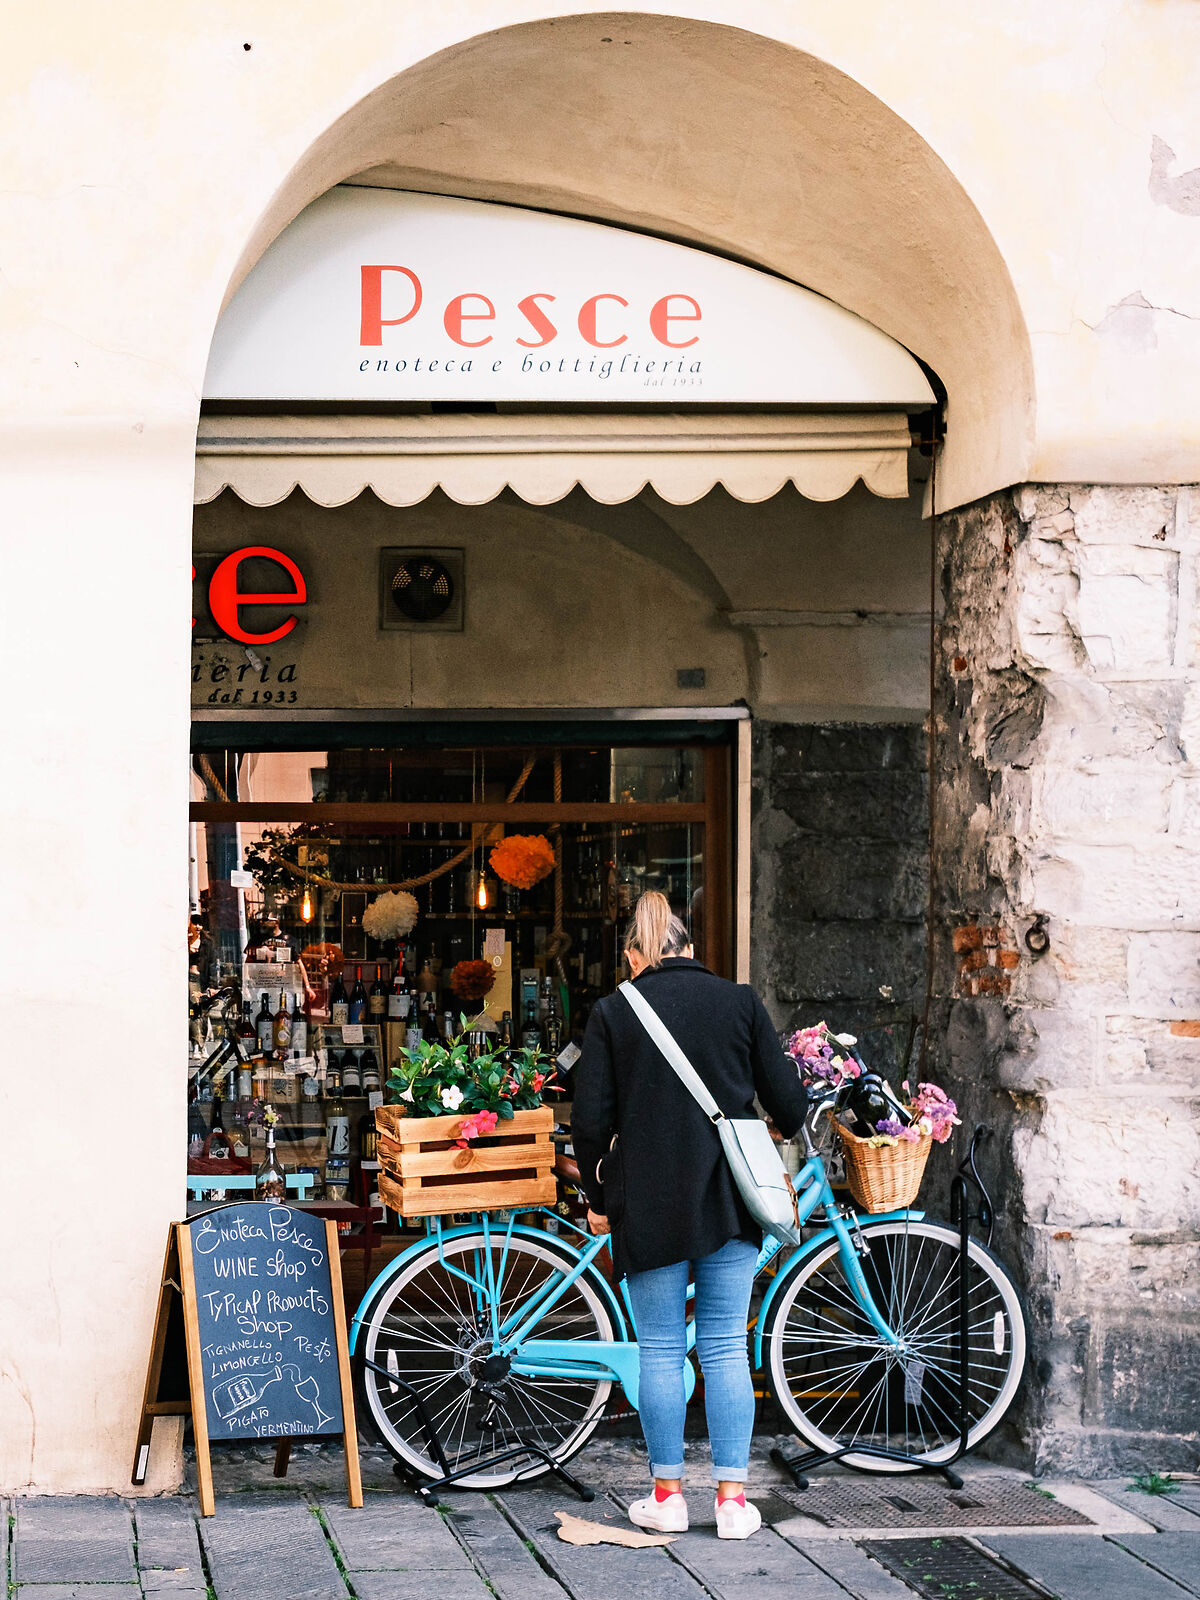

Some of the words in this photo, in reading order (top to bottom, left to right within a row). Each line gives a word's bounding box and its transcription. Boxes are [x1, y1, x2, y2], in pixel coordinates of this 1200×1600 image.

[360, 265, 702, 348] Pesce
[360, 356, 473, 373] enoteca
[492, 359, 503, 373] e
[521, 353, 703, 379] bottiglieria
[208, 688, 244, 703] dal
[252, 690, 298, 703] 1933
[196, 1216, 268, 1254] Enoteca
[268, 1207, 324, 1266] Pesce
[214, 1257, 259, 1279] WINE
[237, 1315, 293, 1341] Shop
[211, 1352, 283, 1378] LIMONCELLO
[226, 1406, 269, 1432] PIGATO
[253, 1420, 314, 1438] VERMENTINO
